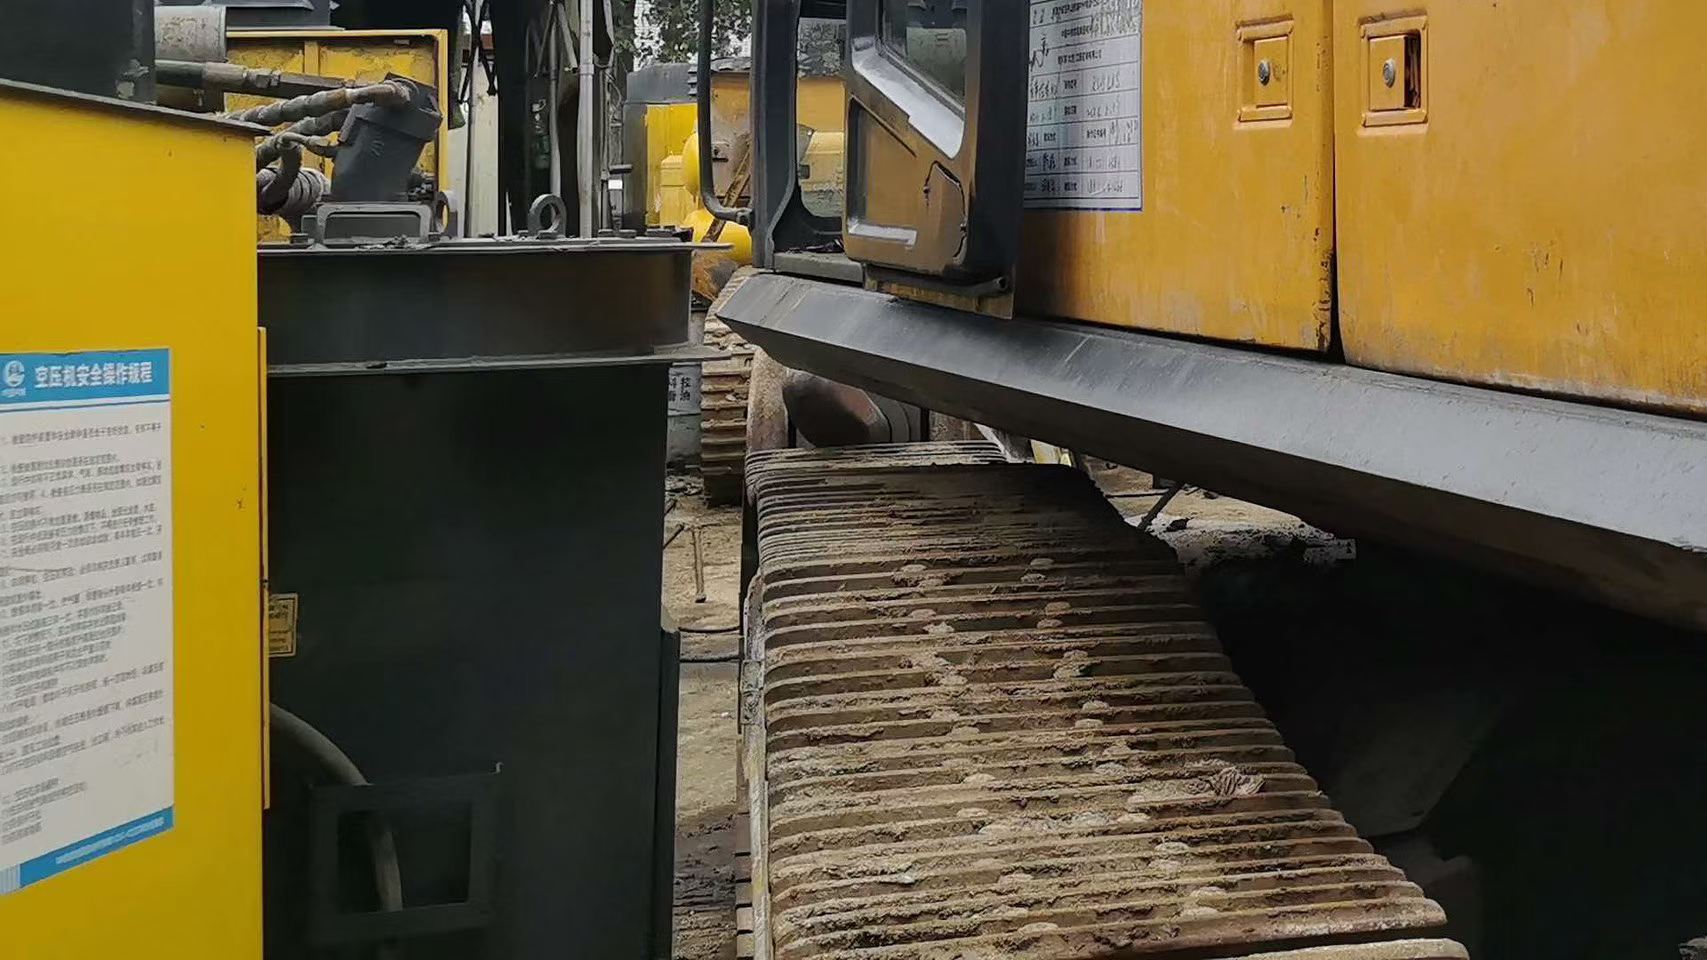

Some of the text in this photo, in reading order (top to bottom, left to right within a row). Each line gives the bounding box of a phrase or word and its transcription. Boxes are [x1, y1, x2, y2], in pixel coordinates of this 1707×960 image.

[34, 361, 152, 388] 空压机安全操作规程
